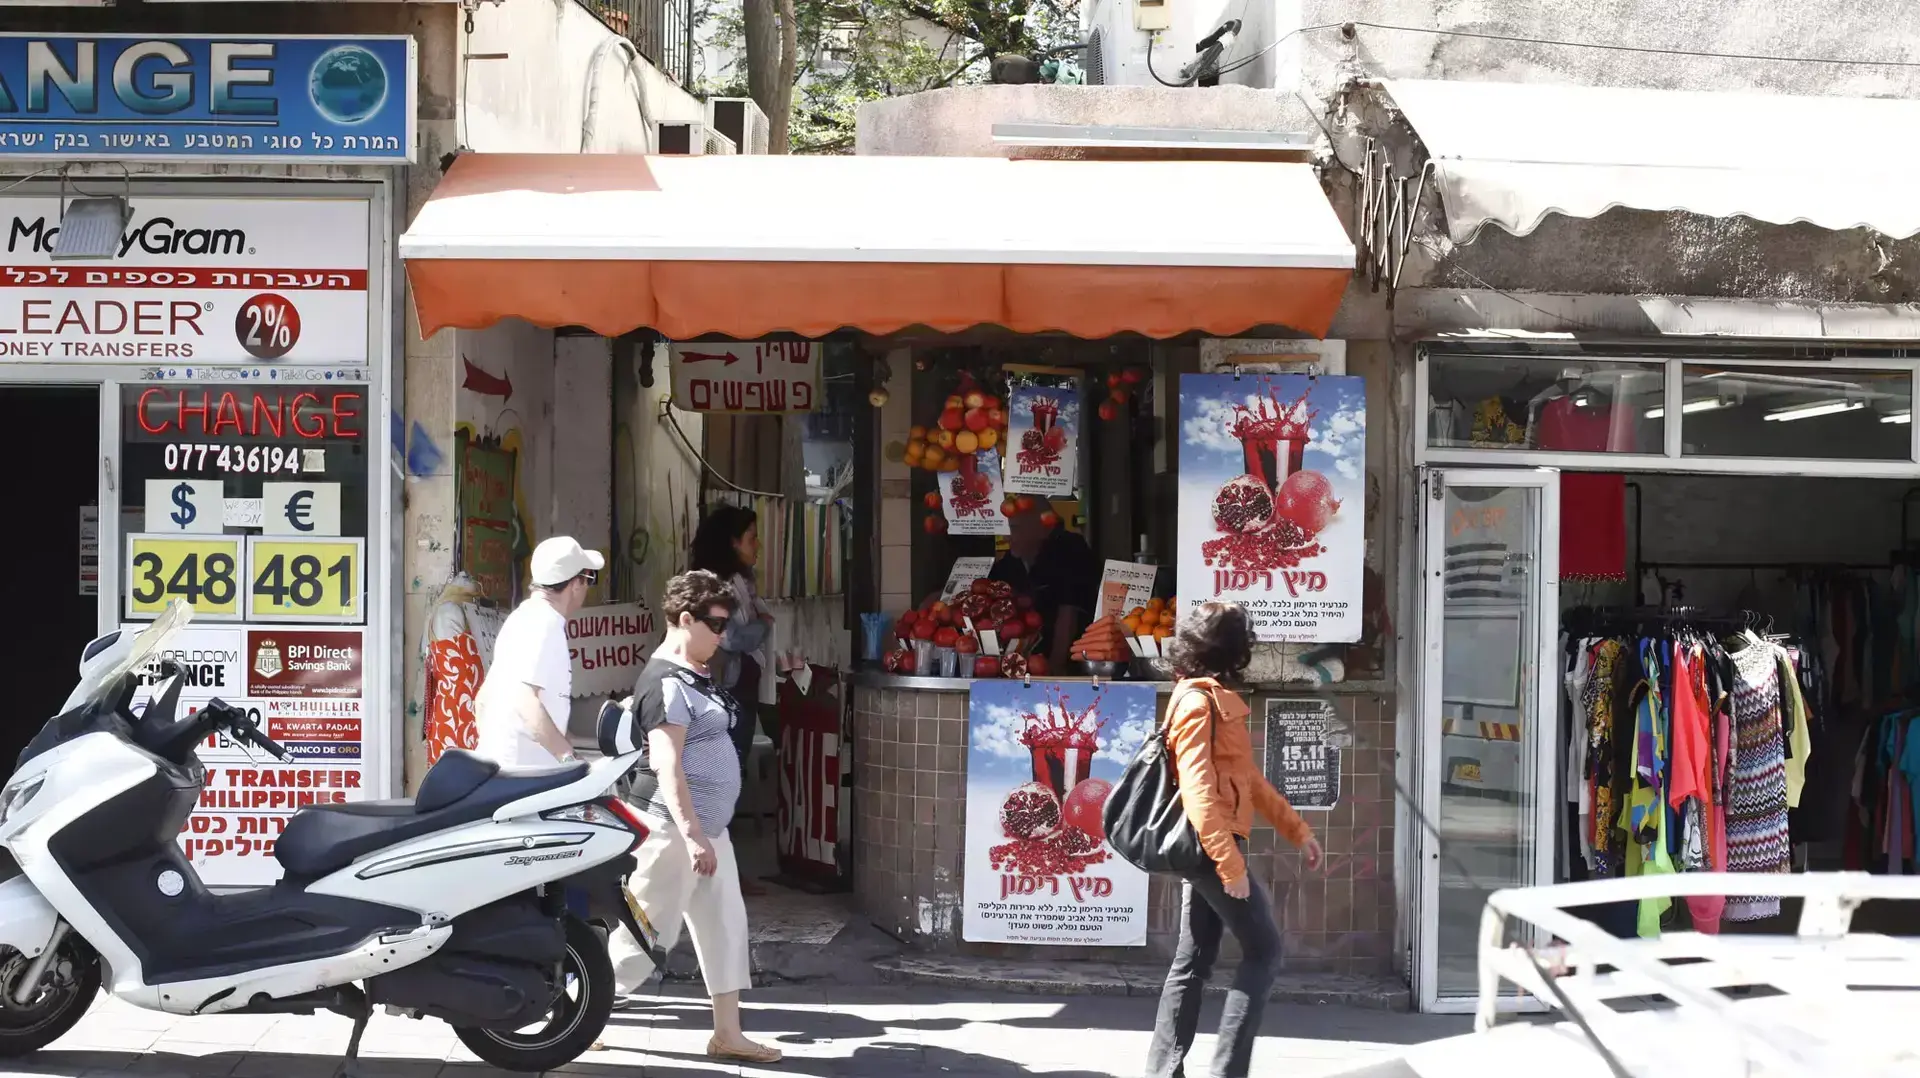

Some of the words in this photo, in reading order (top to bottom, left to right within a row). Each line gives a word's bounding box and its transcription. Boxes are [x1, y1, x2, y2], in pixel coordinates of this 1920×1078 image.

[0, 40, 279, 116] NGE
[54, 133, 90, 150] בנק
[99, 133, 171, 148] באישור
[184, 133, 253, 149] המטבע
[263, 134, 302, 149] סוגי
[311, 131, 334, 149] כל
[343, 134, 399, 149] המרת
[7, 215, 246, 260] MoyGram
[6, 266, 69, 285] לכל
[86, 271, 197, 286] כספים
[211, 273, 351, 287] העברות
[246, 304, 291, 348] 2%
[61, 342, 194, 358] TRANSFERS
[690, 379, 812, 411] פשפשים
[137, 387, 361, 438] CHANGE
[170, 481, 197, 530] $
[284, 489, 315, 532] €
[1213, 569, 1274, 598] רימון
[1281, 570, 1328, 598] מיץ
[1252, 599, 1268, 608] ללא
[1293, 601, 1318, 609] הרימון
[1319, 601, 1349, 609] מגרעיני
[1302, 609, 1318, 617] בתל
[564, 606, 655, 641] ОШИНЫЙ
[1294, 620, 1318, 628] הטעם
[288, 645, 310, 659] BPI
[313, 645, 353, 659] Direct
[288, 660, 325, 673] Savings
[326, 660, 352, 671] Bank
[271, 723, 284, 731] ML
[286, 723, 323, 731] KWARTA
[326, 723, 360, 731] PADALA
[286, 745, 321, 754] BANCO
[323, 746, 336, 754] DE
[337, 746, 360, 754] ORO
[1282, 745, 1325, 760] 15.11
[1282, 761, 1298, 770] בר
[225, 769, 361, 788] TRANSFER
[199, 790, 347, 809] HILIPPINES
[999, 874, 1060, 901] רימון
[1067, 875, 1113, 903] מיץ
[978, 901, 1008, 911] הקליפה
[1009, 903, 1036, 911] מרירות
[1037, 903, 1054, 911] ללא
[1079, 905, 1103, 914] הרימון
[1105, 906, 1134, 914] מגרעיני
[1034, 914, 1066, 922] שמפריד
[1068, 914, 1086, 922] אביב
[1088, 914, 1104, 922] בתל
